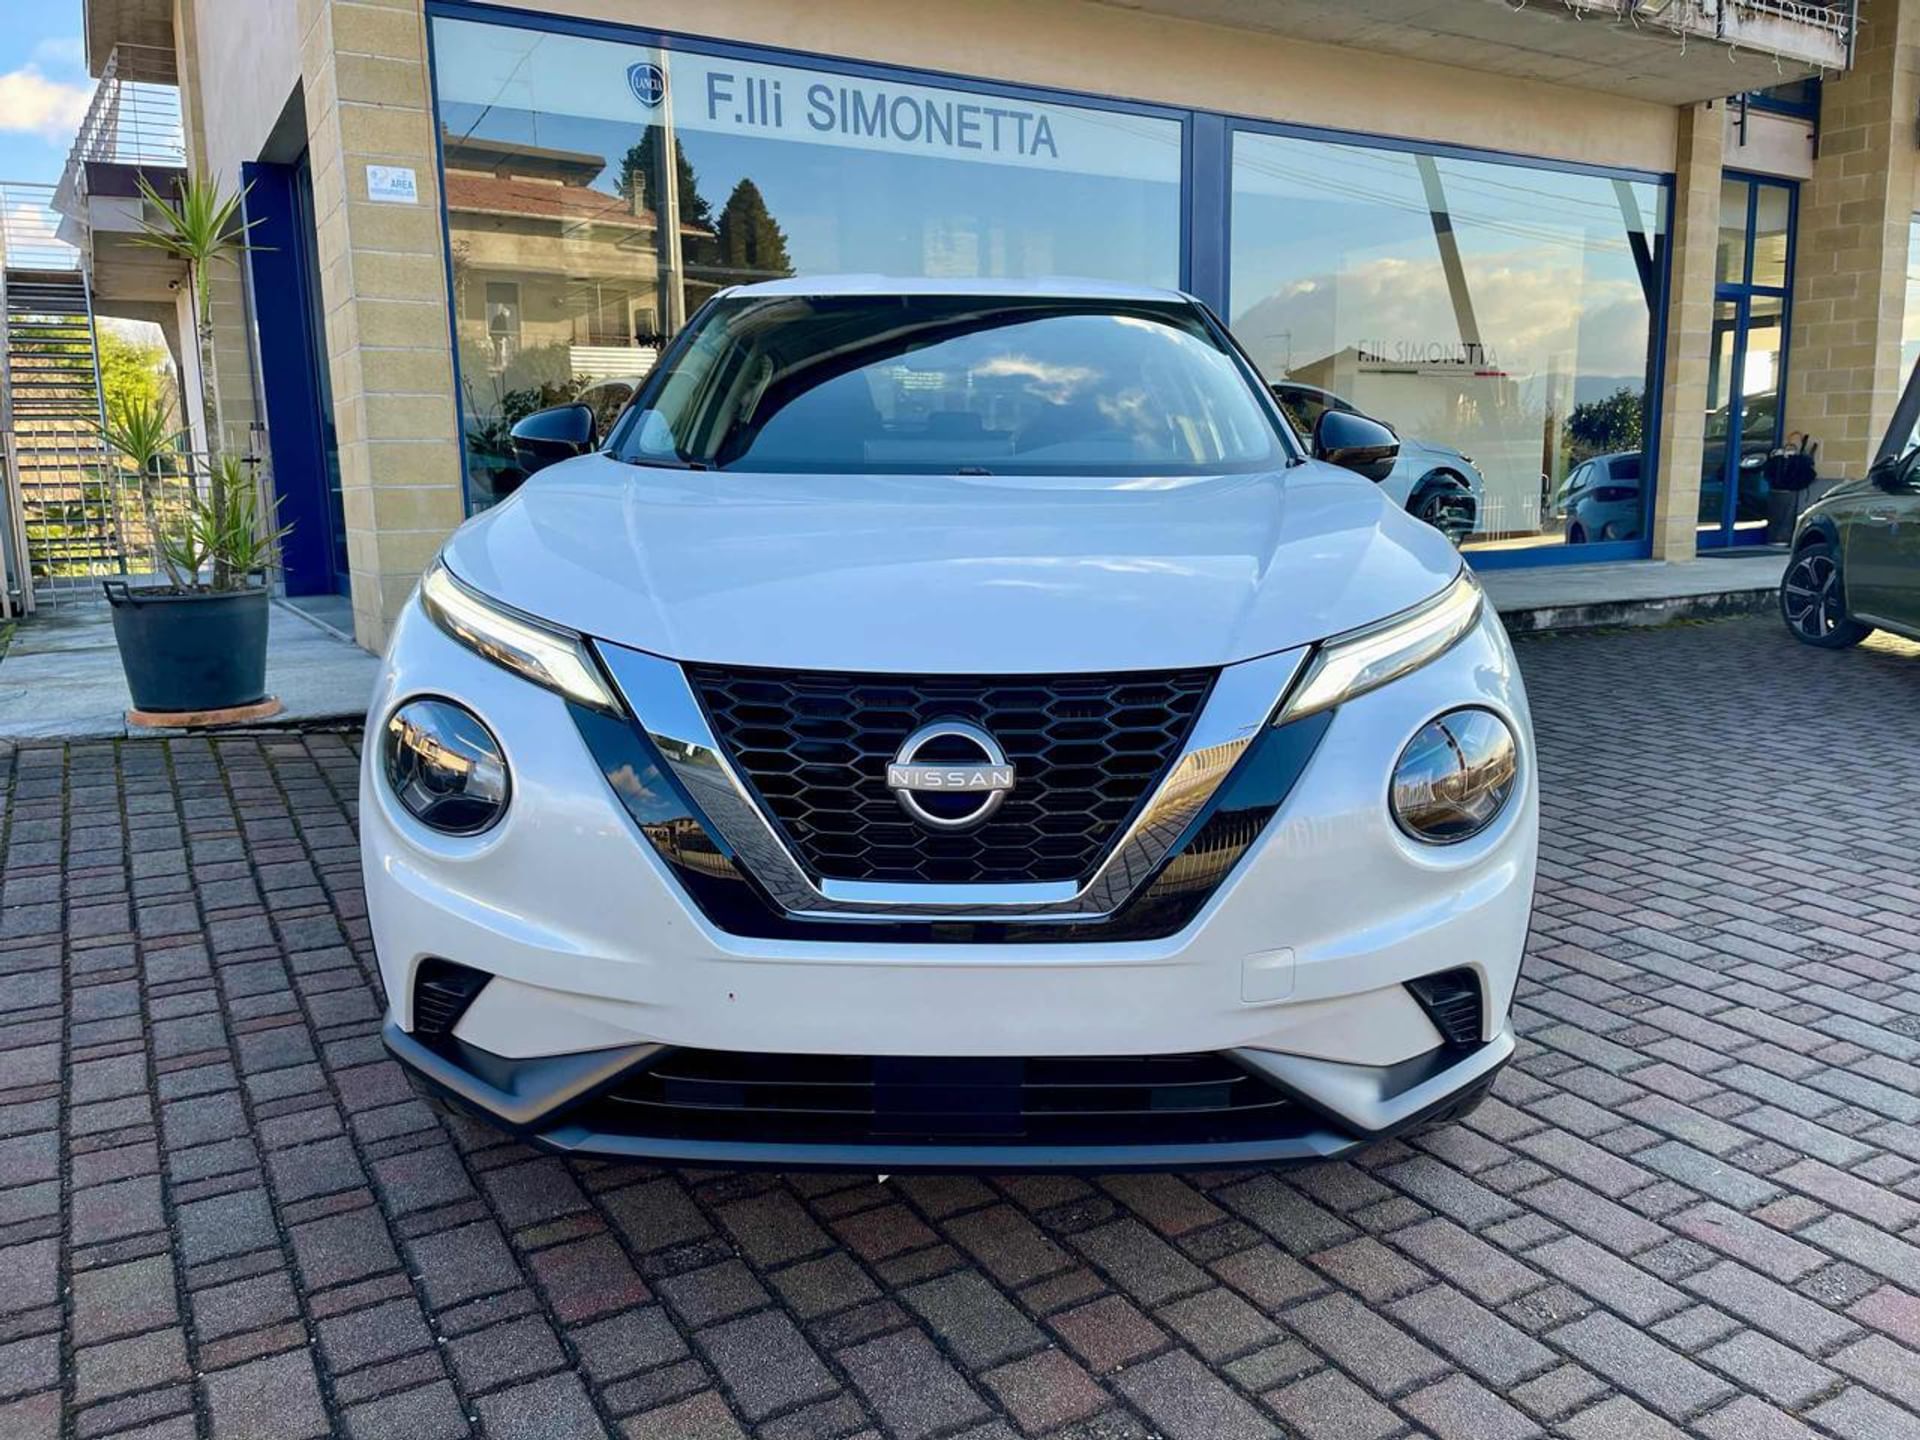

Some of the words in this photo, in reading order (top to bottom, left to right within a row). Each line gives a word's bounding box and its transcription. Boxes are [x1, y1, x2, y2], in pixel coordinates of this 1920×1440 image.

[706, 71, 782, 128] F.lli
[806, 83, 1059, 158] SIMONETTA
[1394, 341, 1498, 366] SIMONETTA
[890, 769, 1011, 787] NISSAN
